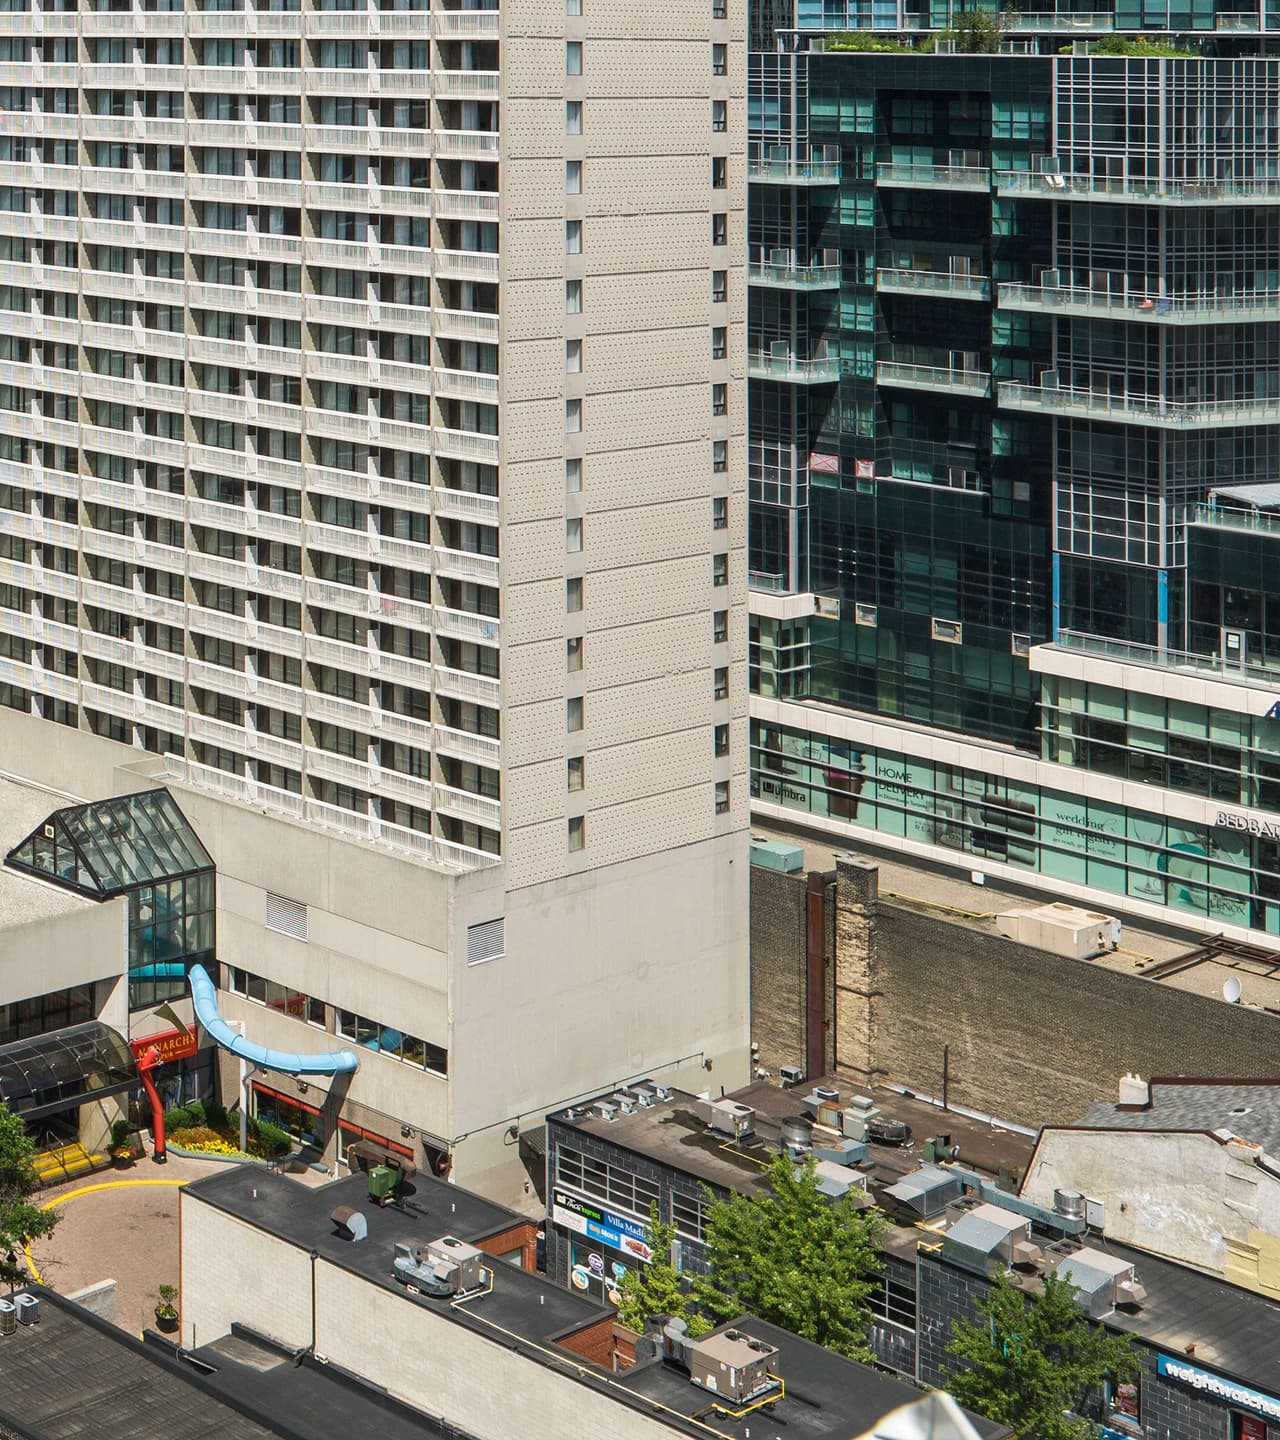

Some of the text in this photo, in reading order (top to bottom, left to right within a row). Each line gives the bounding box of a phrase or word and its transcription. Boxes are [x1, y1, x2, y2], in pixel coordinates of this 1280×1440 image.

[879, 766, 913, 783] HOME
[775, 783, 806, 802] umbra
[879, 782, 926, 800] DELIVERY
[1056, 812, 1105, 831] wedding
[138, 1034, 195, 1058] MNARCHS
[608, 1215, 625, 1229] Villa
